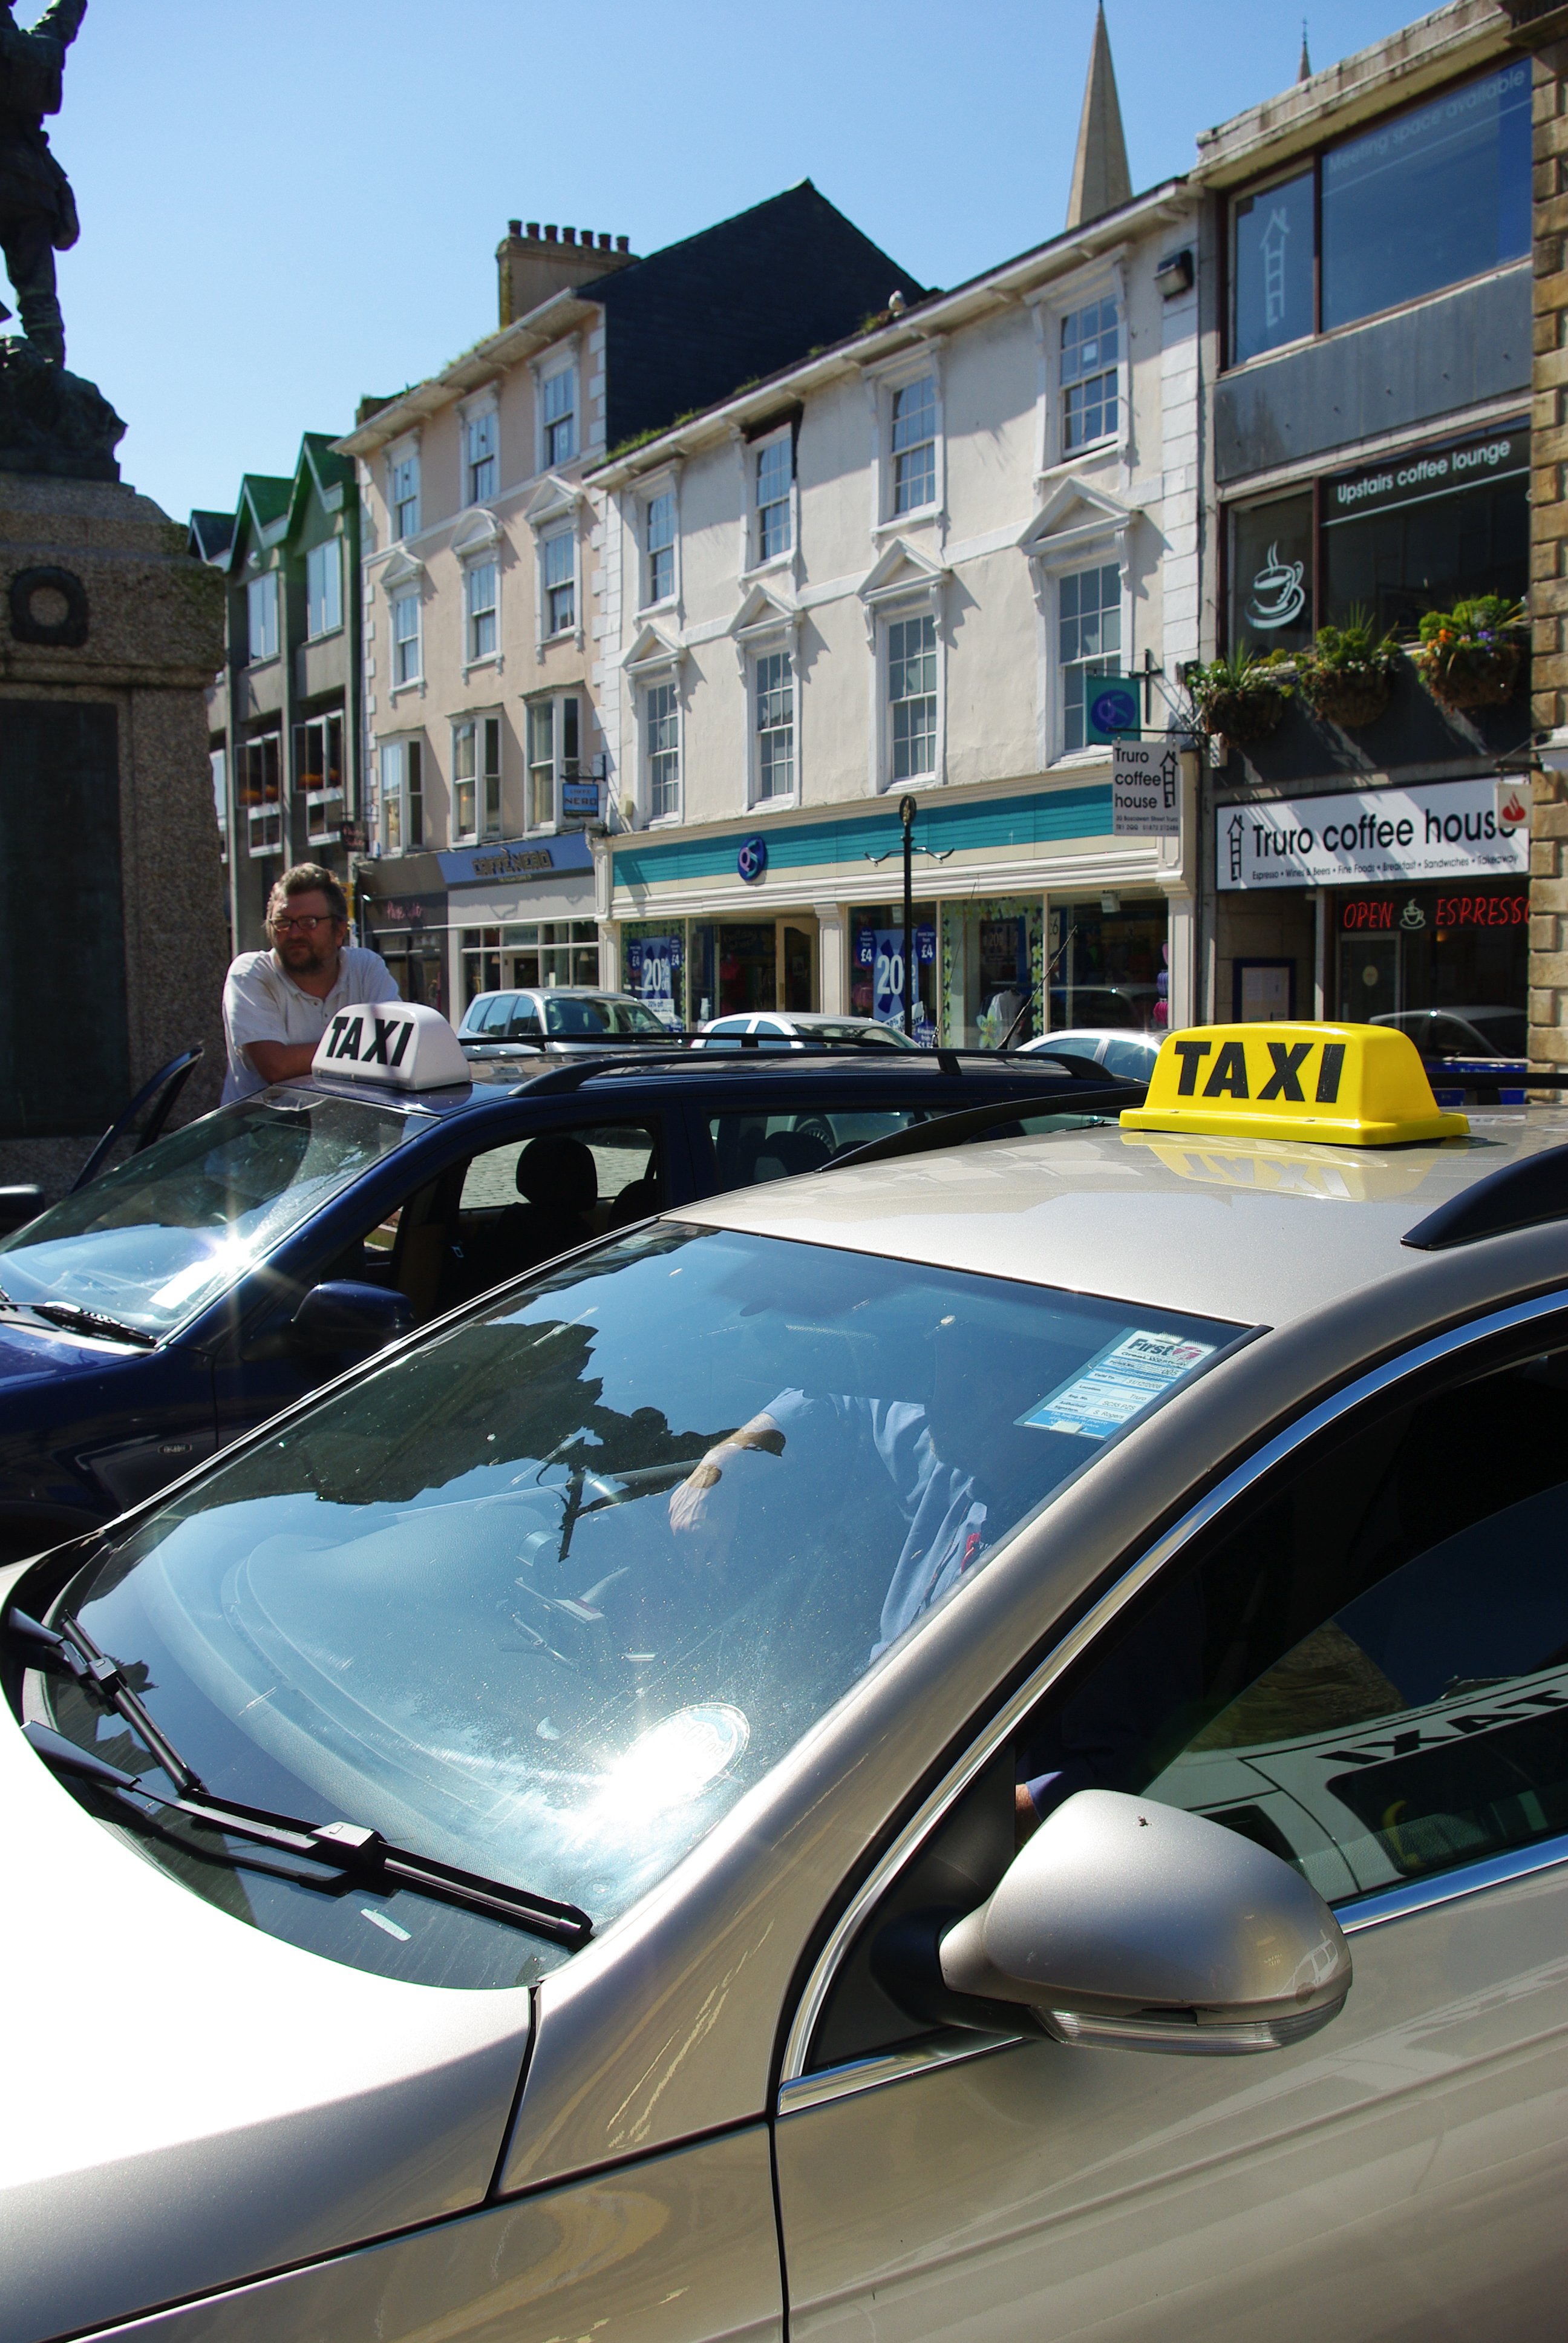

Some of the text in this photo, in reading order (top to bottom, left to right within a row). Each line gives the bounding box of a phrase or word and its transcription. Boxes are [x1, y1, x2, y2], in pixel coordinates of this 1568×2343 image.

[1328, 70, 1525, 174] Meeting space available
[1338, 441, 1511, 505] Upstairs coffee lounge
[1116, 748, 1149, 763] Truro
[1115, 772, 1161, 785] coffee
[1116, 794, 1157, 808] house
[1253, 824, 1313, 857] Truro
[1323, 813, 1414, 851] coffee
[1253, 871, 1279, 880] Espresso
[1314, 867, 1331, 875] Beers
[1338, 865, 1352, 874] Fine
[1354, 863, 1374, 873] Foods
[1383, 860, 1416, 871] Breakfast
[1424, 857, 1469, 868] Sandwiches
[1477, 855, 1518, 865] Takeaway
[1344, 902, 1393, 928] OPEN
[671, 954, 679, 966] £4
[861, 949, 872, 962] £4
[921, 945, 933, 958] £4
[325, 1017, 414, 1067] TAXI
[1174, 1041, 1345, 1103] TAXI
[1127, 1338, 1175, 1356] First
[1102, 1411, 1125, 1420] Rogers
